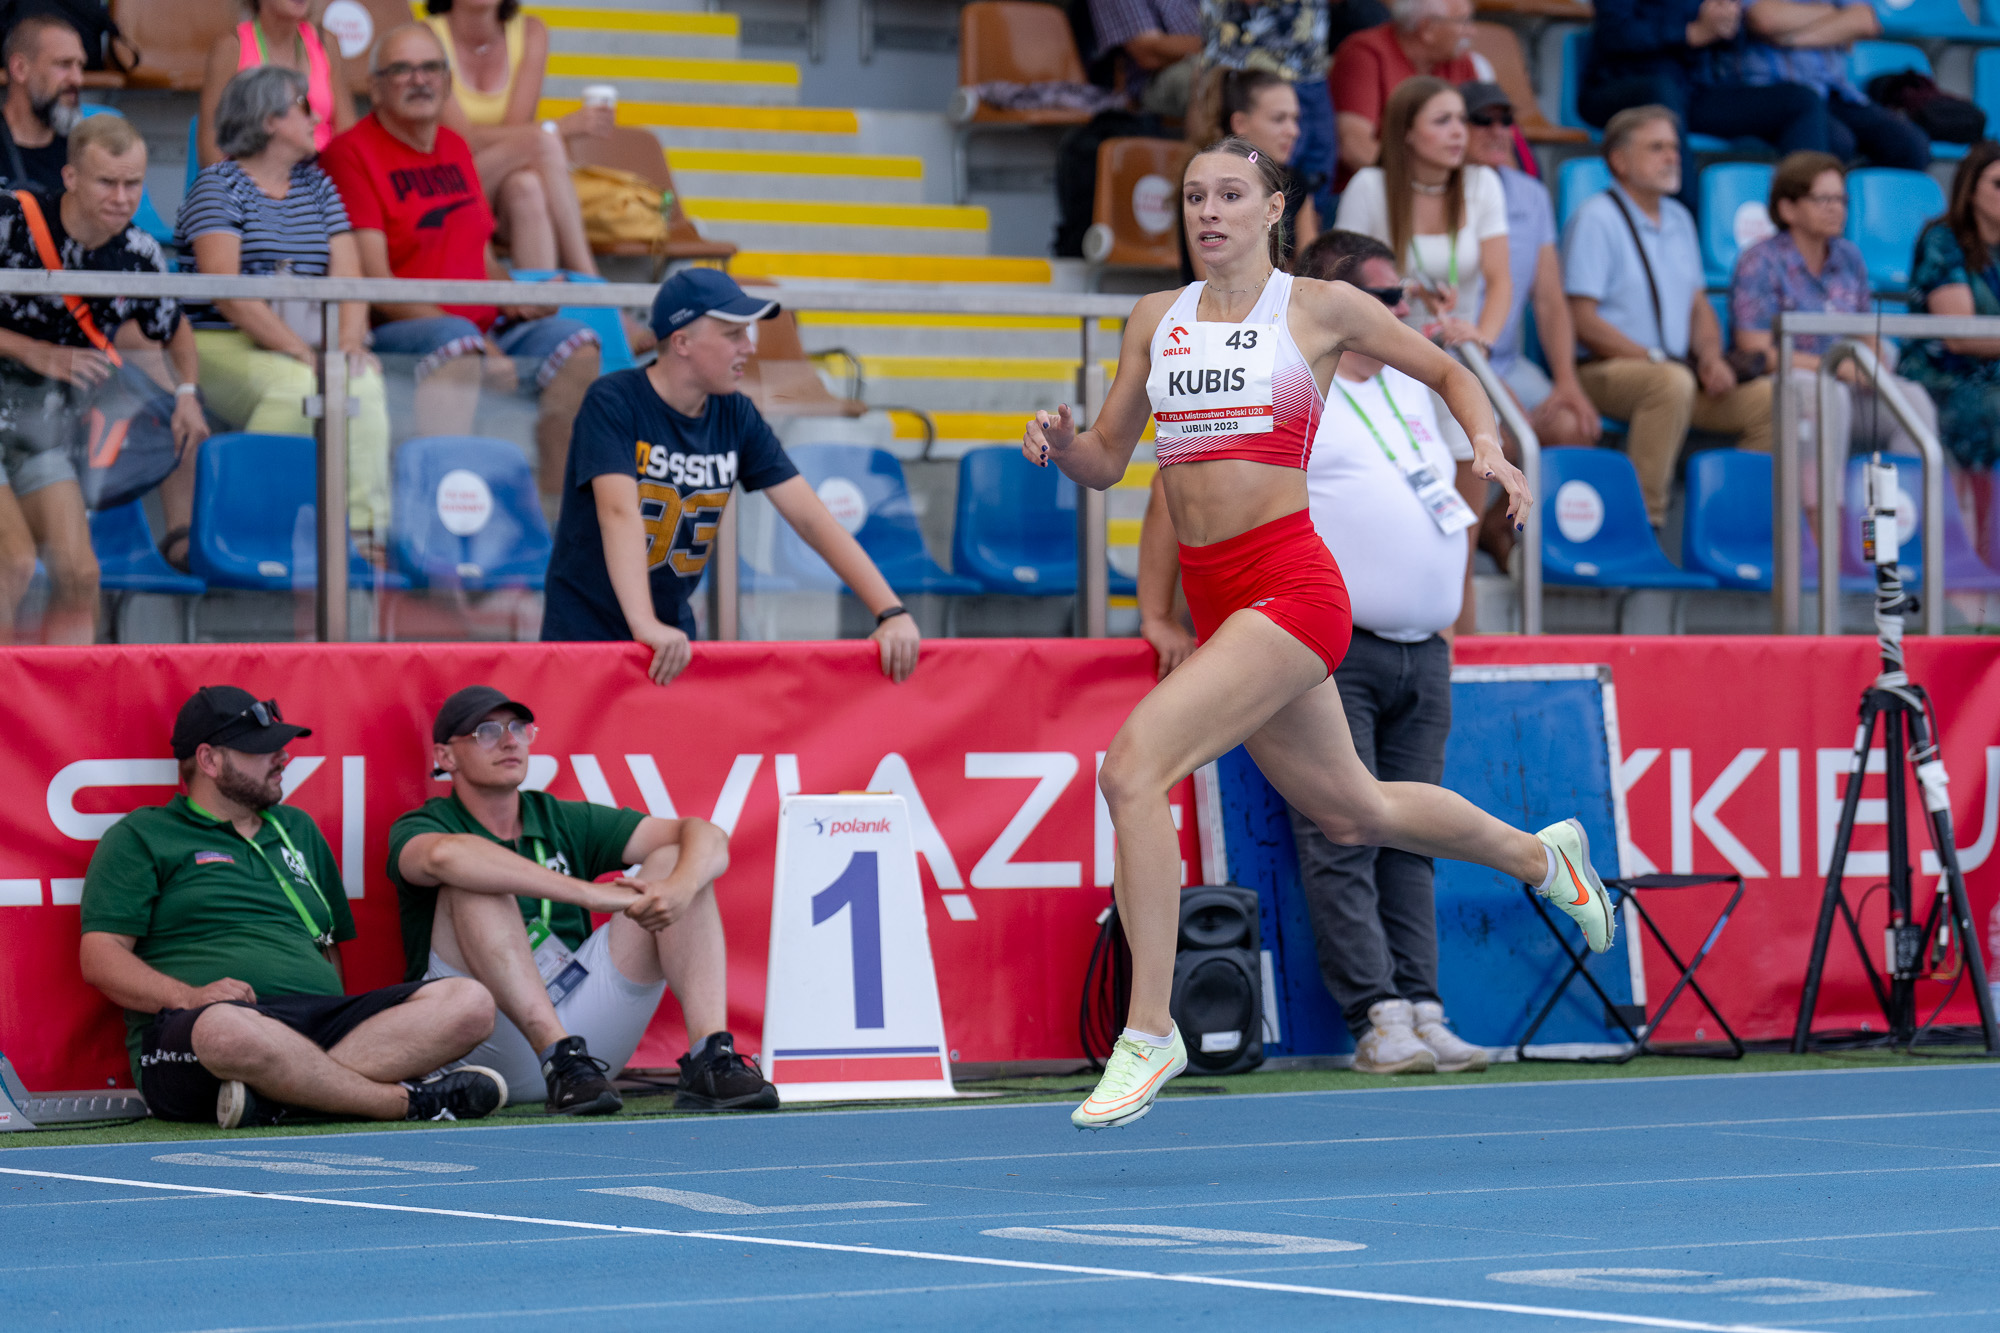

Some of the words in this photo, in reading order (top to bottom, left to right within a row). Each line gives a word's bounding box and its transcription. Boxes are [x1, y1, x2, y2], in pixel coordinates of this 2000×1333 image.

[1225, 330, 1258, 350] 43
[1163, 347, 1190, 356] ORLEN
[1169, 367, 1246, 396] KUBIS
[1184, 411, 1225, 420] Mistrzostwa
[1225, 408, 1247, 417] Polski
[1248, 407, 1264, 415] U20
[1181, 423, 1212, 434] LUBLIN
[1214, 421, 1239, 431] 2023
[829, 816, 891, 837] polanik
[811, 851, 885, 1029] 1
